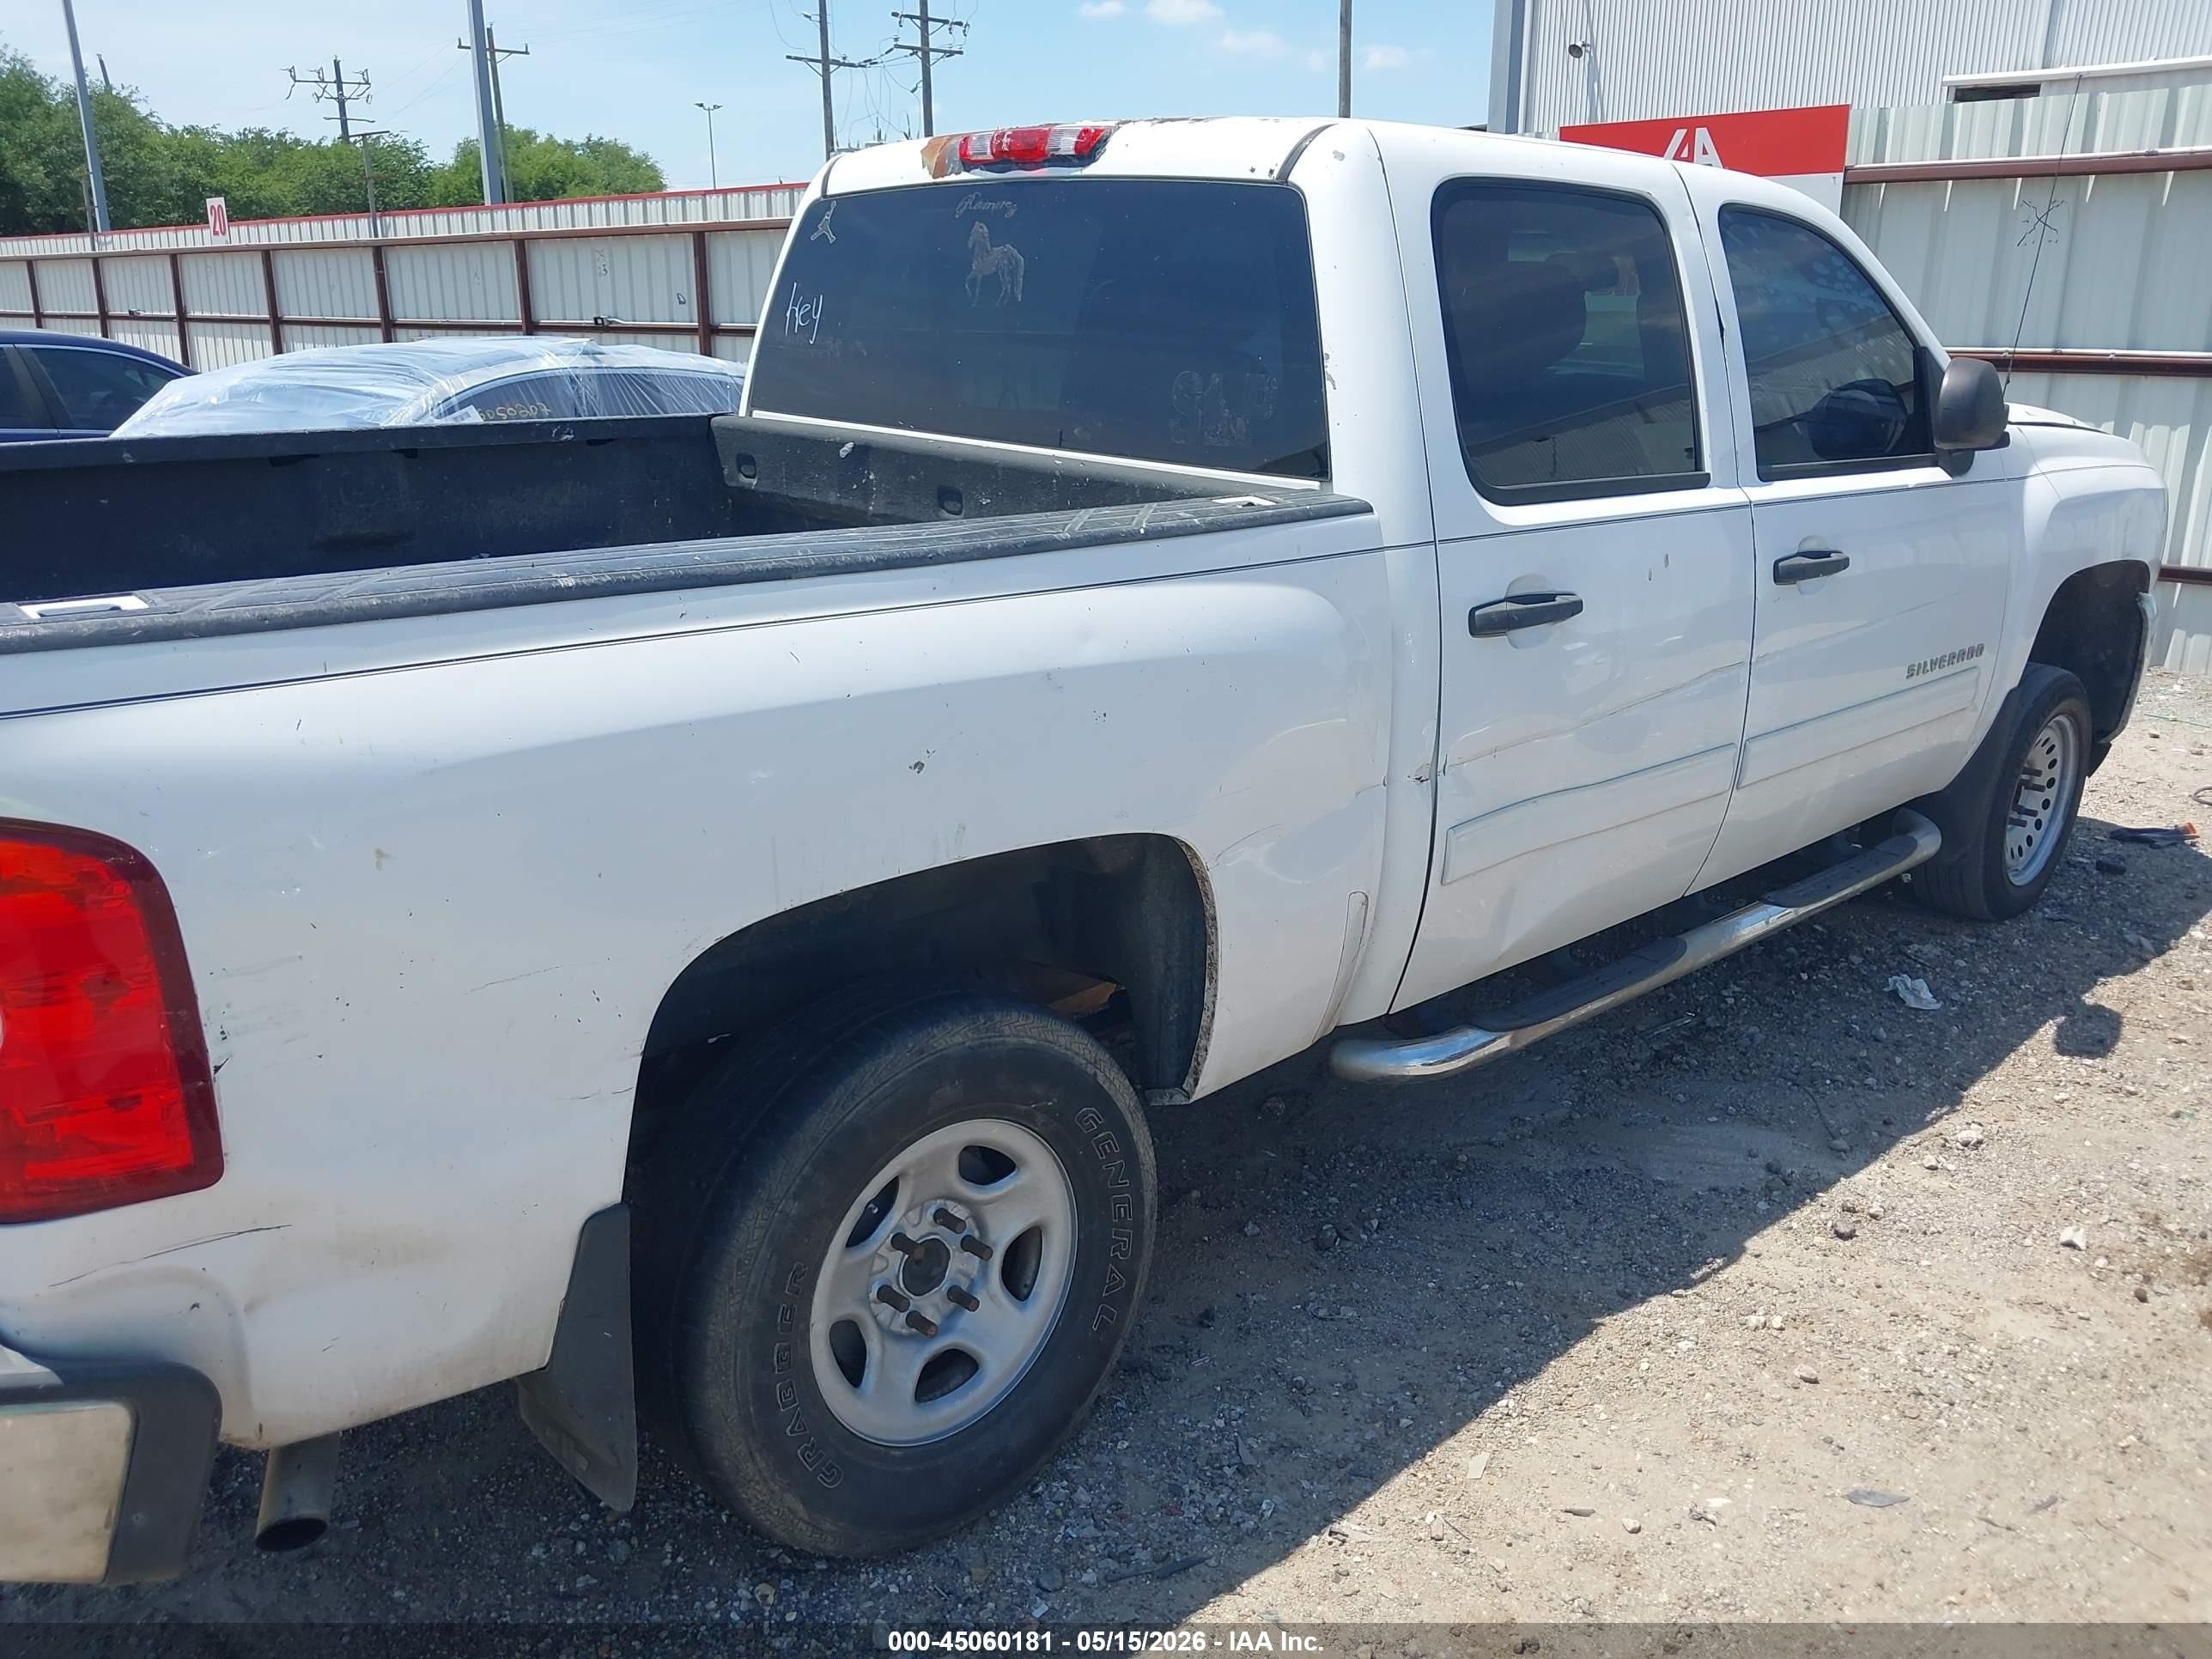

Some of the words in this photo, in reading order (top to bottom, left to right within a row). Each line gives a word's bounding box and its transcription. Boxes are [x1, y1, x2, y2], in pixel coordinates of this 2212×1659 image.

[210, 204, 227, 235] 20
[785, 282, 823, 344] Hey
[1905, 642, 1985, 679] SILVERADO
[1074, 1107, 1133, 1332] GENERAL
[774, 1261, 844, 1489] GRABBER
